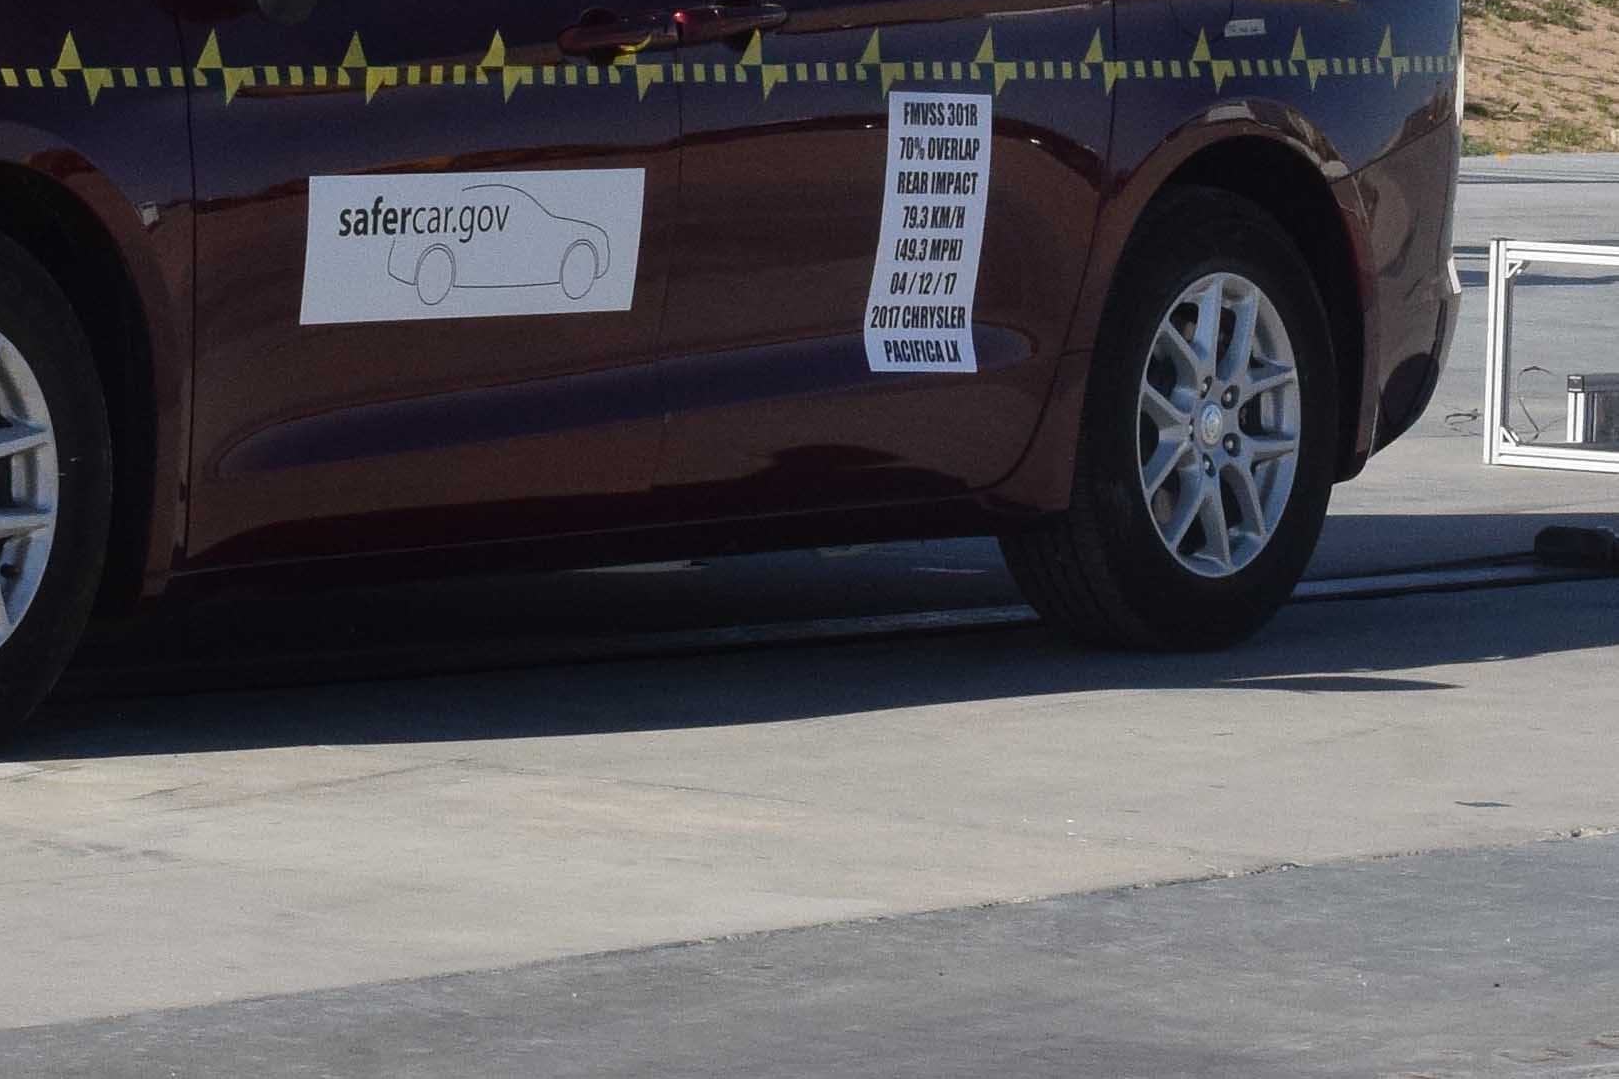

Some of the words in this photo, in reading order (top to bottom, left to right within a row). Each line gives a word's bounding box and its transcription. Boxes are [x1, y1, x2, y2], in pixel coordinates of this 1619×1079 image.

[904, 102, 944, 126] FMVSS
[947, 103, 978, 126] 301R
[899, 136, 925, 160] 70%
[928, 137, 980, 161] OVERLAP
[897, 171, 929, 195] REAR
[931, 172, 978, 194] IMPACT
[338, 195, 510, 243] safercar.gov
[903, 205, 929, 229] 79.3
[930, 206, 965, 229] KM/H
[870, 305, 901, 328] 2017
[902, 305, 966, 328] CHRYSLER
[883, 339, 945, 362] PACIFICA
[944, 339, 962, 362] LX
